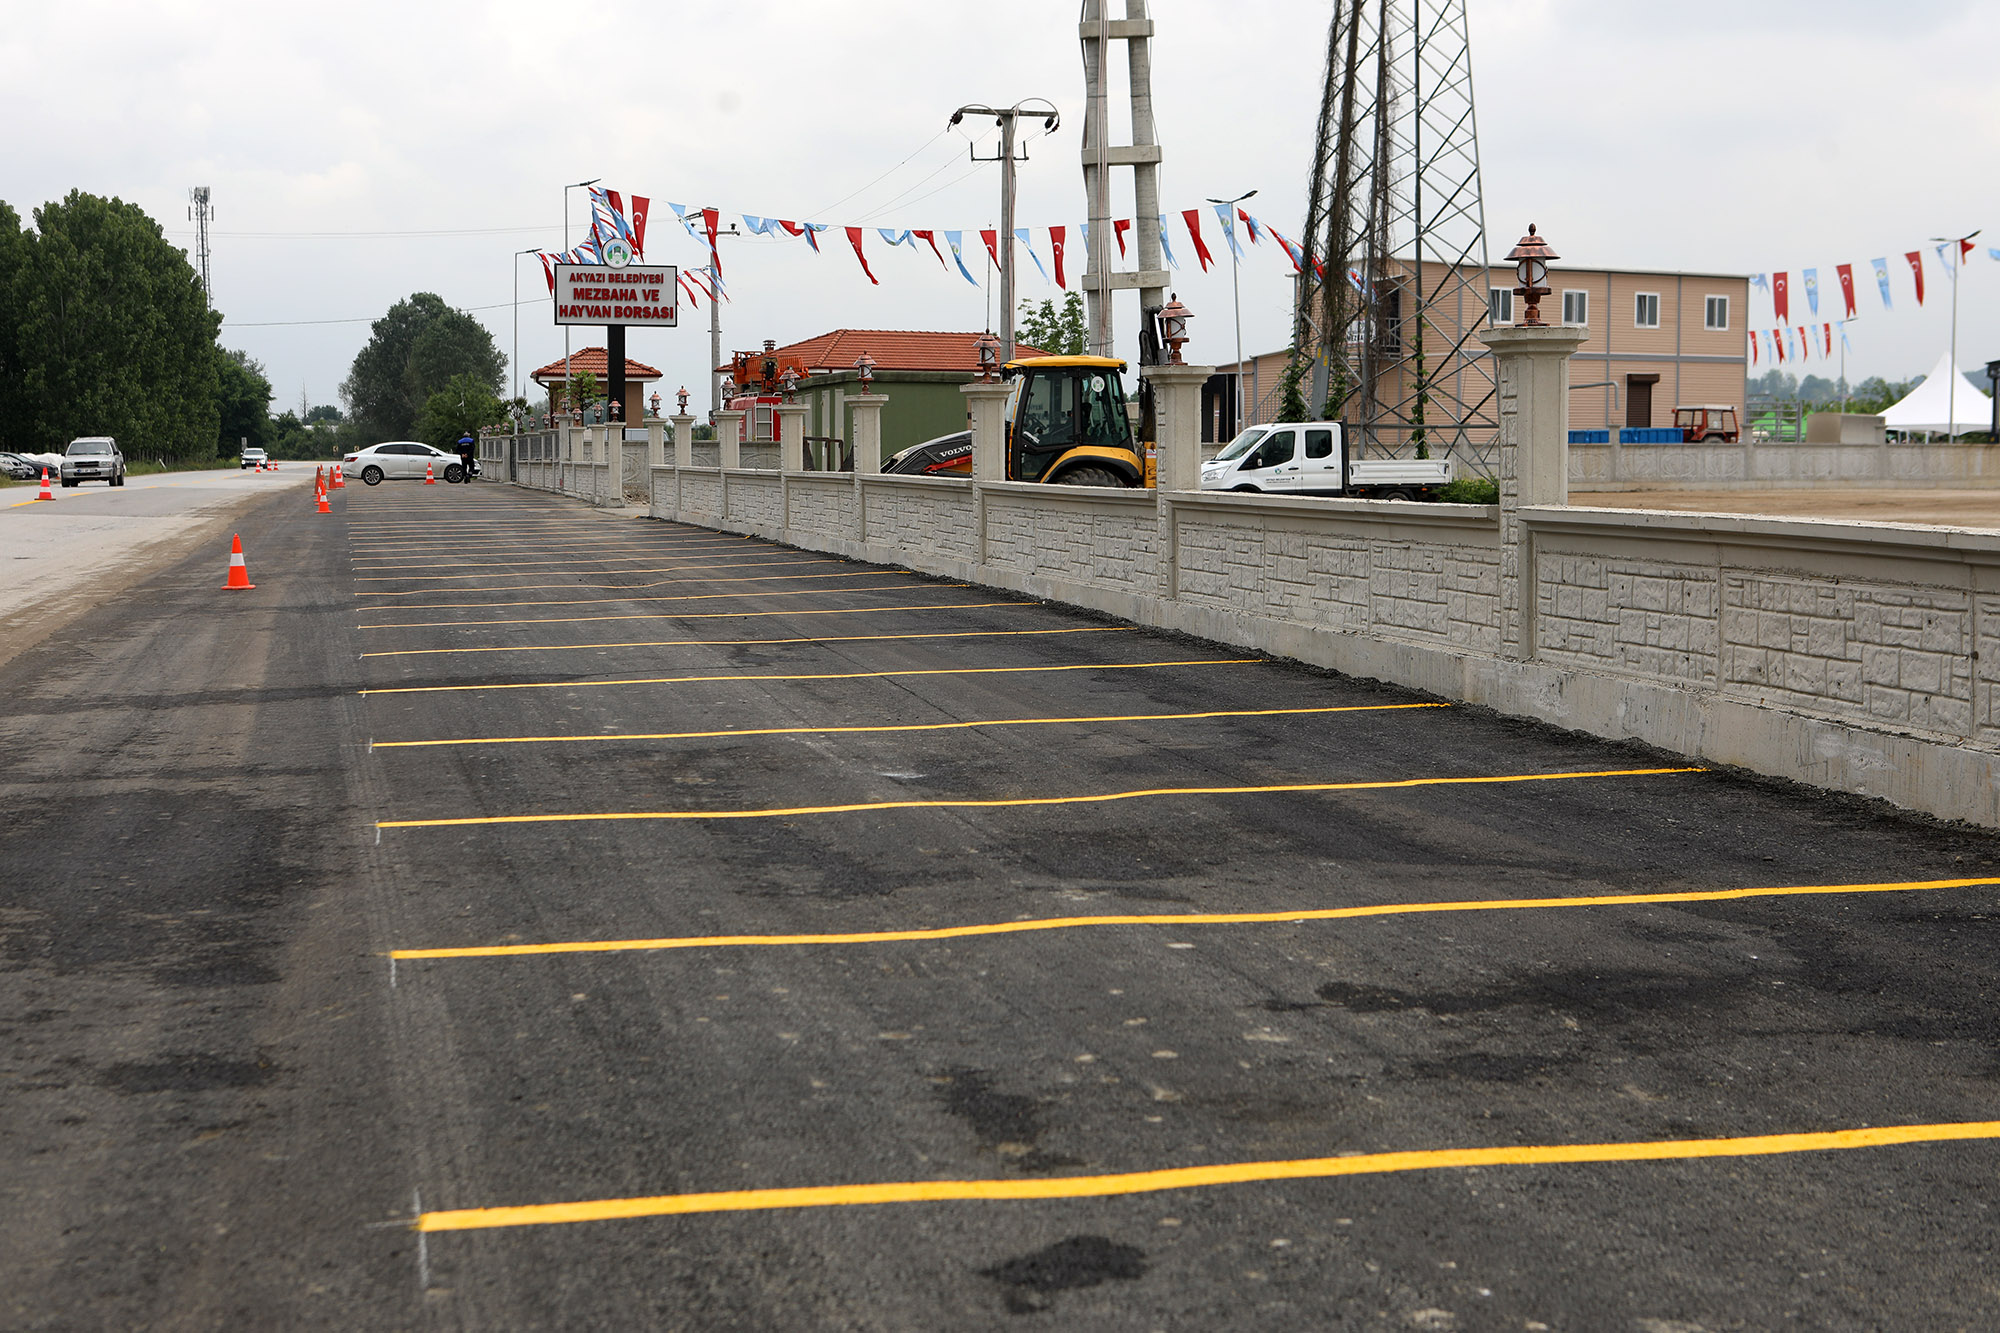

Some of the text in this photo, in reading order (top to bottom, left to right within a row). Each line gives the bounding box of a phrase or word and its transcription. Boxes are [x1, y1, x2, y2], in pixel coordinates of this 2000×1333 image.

[569, 273, 664, 284] AKYAZI BELEDİYESİ
[573, 288, 660, 301] MEZBAHA VE
[559, 304, 674, 319] HAYVAN BORSASI
[940, 445, 972, 457] VOLVO
